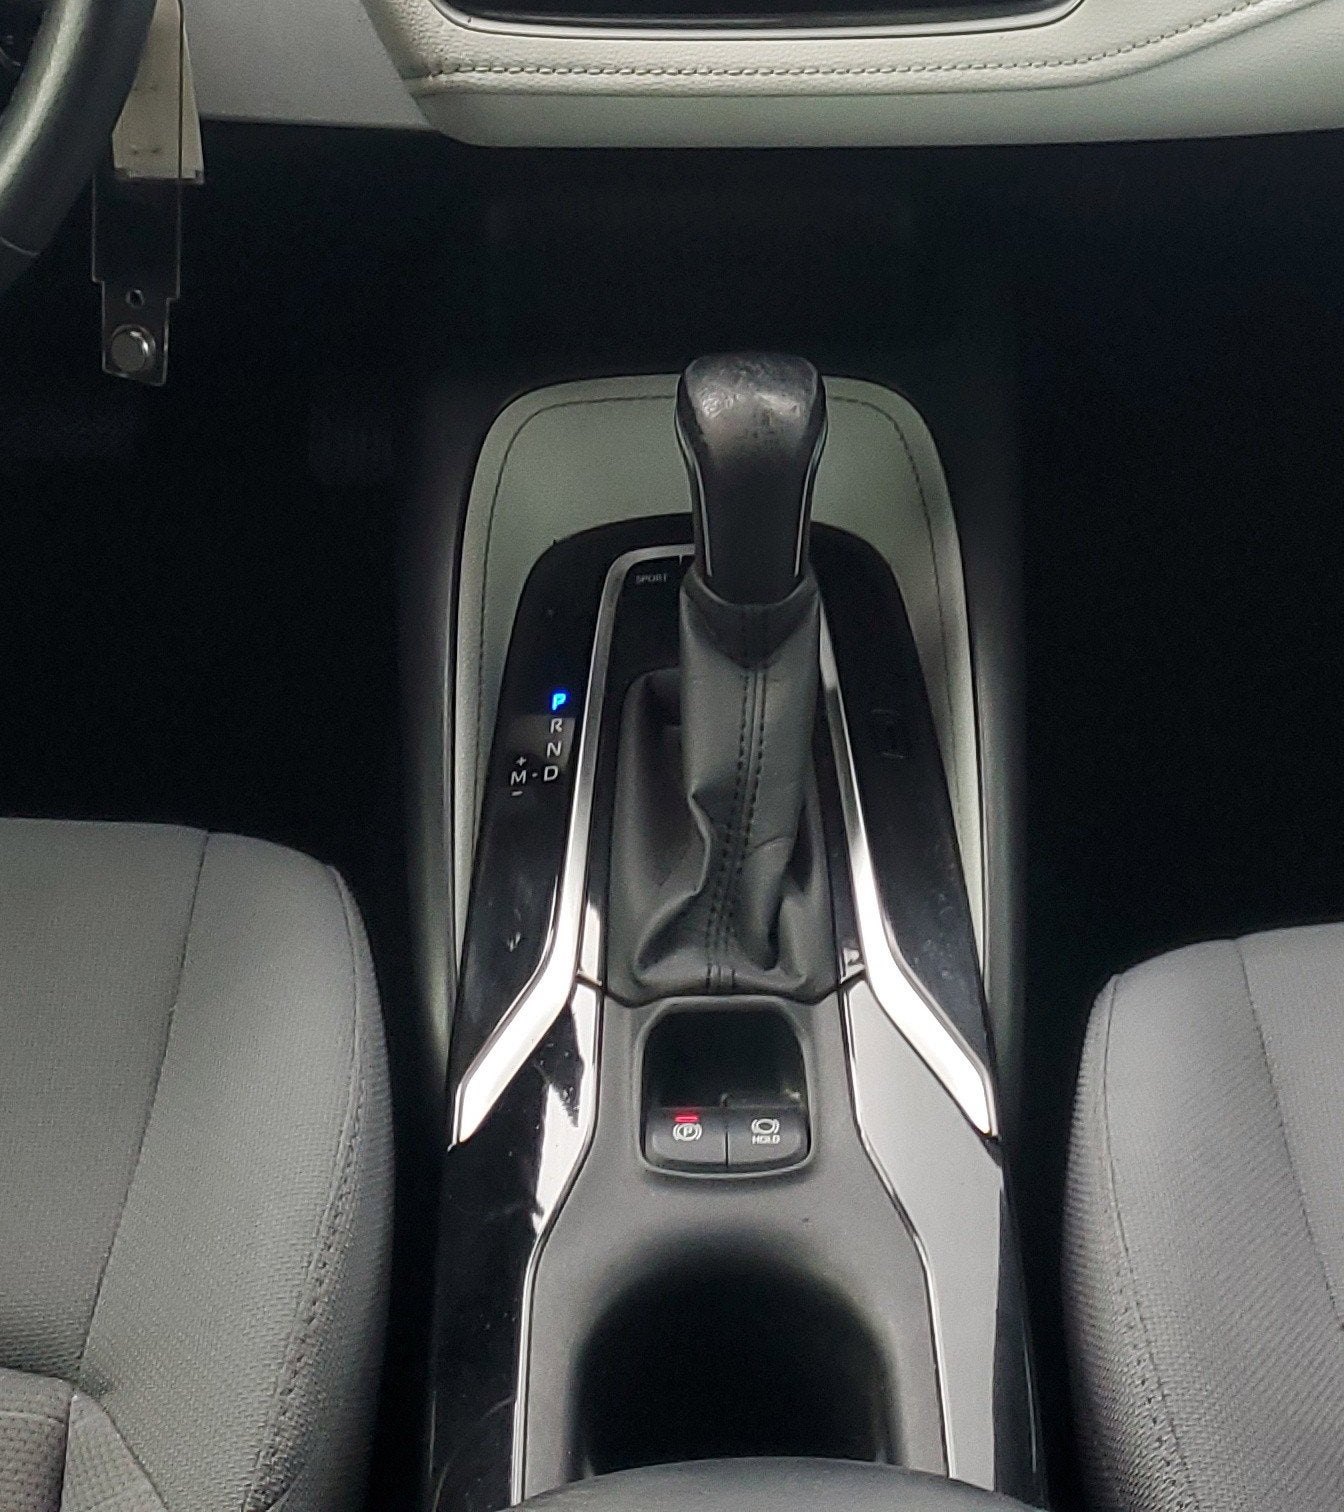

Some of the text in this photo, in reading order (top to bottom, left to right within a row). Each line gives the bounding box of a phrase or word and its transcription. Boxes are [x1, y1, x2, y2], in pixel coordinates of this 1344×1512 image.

[551, 692, 567, 711] P
[549, 717, 563, 734] R
[546, 739, 562, 759] N
[510, 764, 559, 787] M D
[752, 1133, 781, 1145] HOLD
